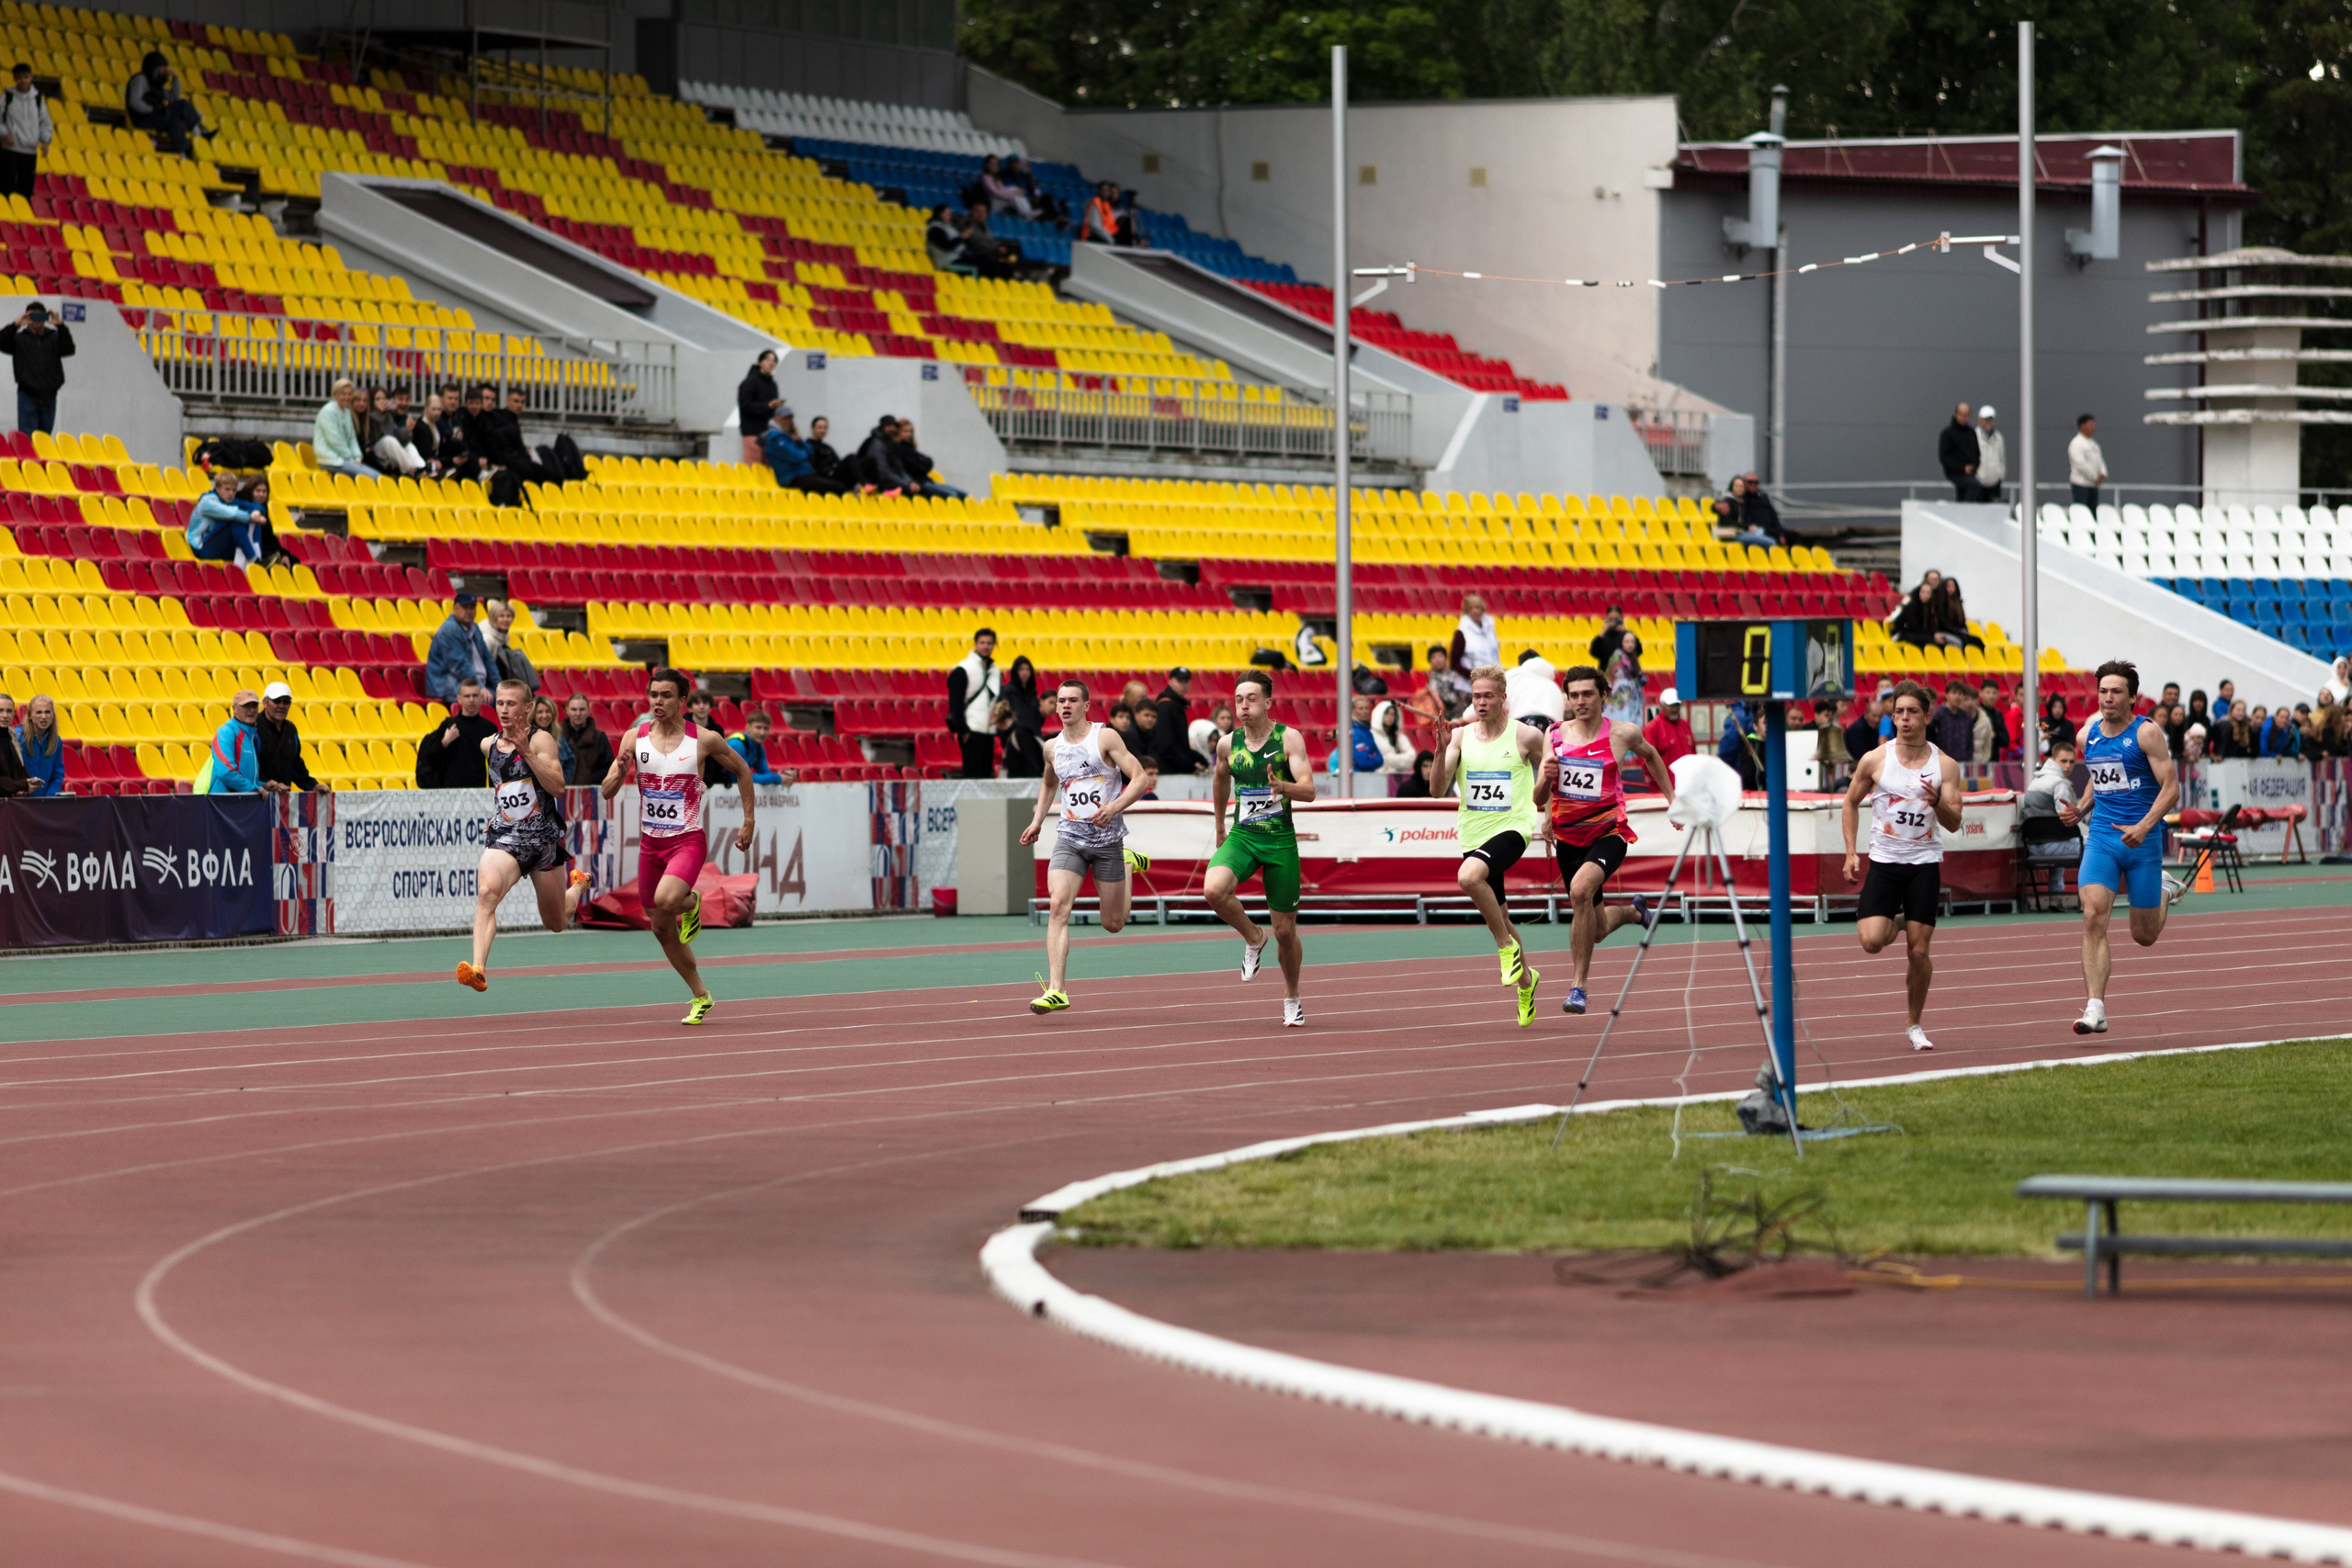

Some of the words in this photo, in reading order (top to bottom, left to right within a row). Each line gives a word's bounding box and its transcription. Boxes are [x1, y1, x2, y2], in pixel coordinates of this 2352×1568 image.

[1741, 626, 1770, 694] 0
[1563, 771, 1594, 789] 242
[2091, 768, 2120, 784] 264
[501, 792, 530, 809] 303
[1069, 790, 1101, 807] 306
[1471, 785, 1504, 800] 734
[647, 803, 678, 818] 866
[1895, 811, 1926, 827] 312
[345, 812, 461, 849] ВСЕРОССИЙСКАЯ
[1399, 827, 1459, 843] polanik
[67, 851, 137, 892] ВФЛА
[187, 848, 254, 887] ВФЛА
[393, 871, 445, 898] СПОРТА
